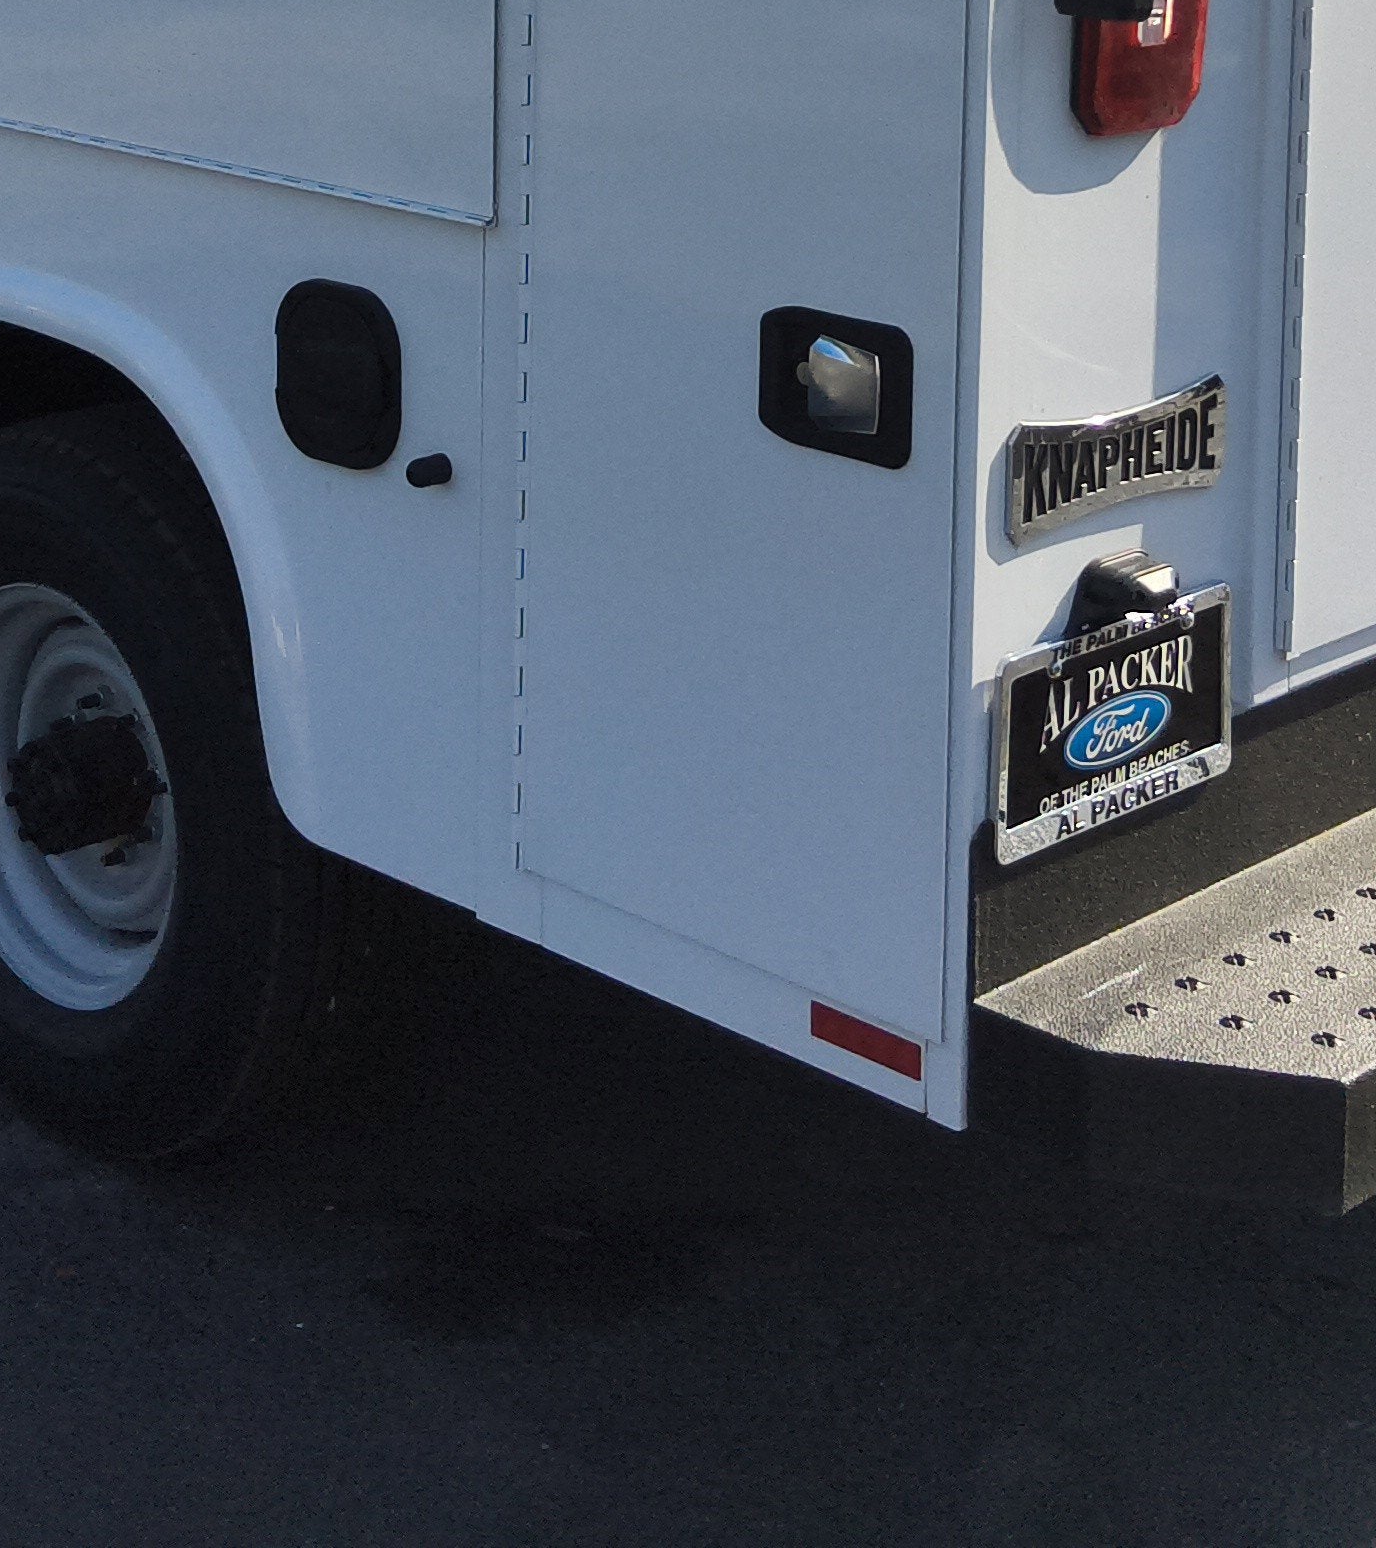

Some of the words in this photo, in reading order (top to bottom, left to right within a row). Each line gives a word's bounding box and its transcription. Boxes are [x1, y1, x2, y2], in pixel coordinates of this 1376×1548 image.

[1022, 393, 1219, 523] KNAPHEIDE
[1050, 639, 1081, 660] THE
[1040, 678, 1080, 753] AL
[1087, 635, 1193, 710] PACKER
[1085, 704, 1150, 759] Ford
[1039, 793, 1059, 815] OF
[1062, 780, 1088, 804] THE
[1091, 766, 1126, 795] PALM
[1129, 739, 1190, 778] BEACHES
[1055, 807, 1086, 840] AL
[1091, 766, 1179, 825] PACKER
